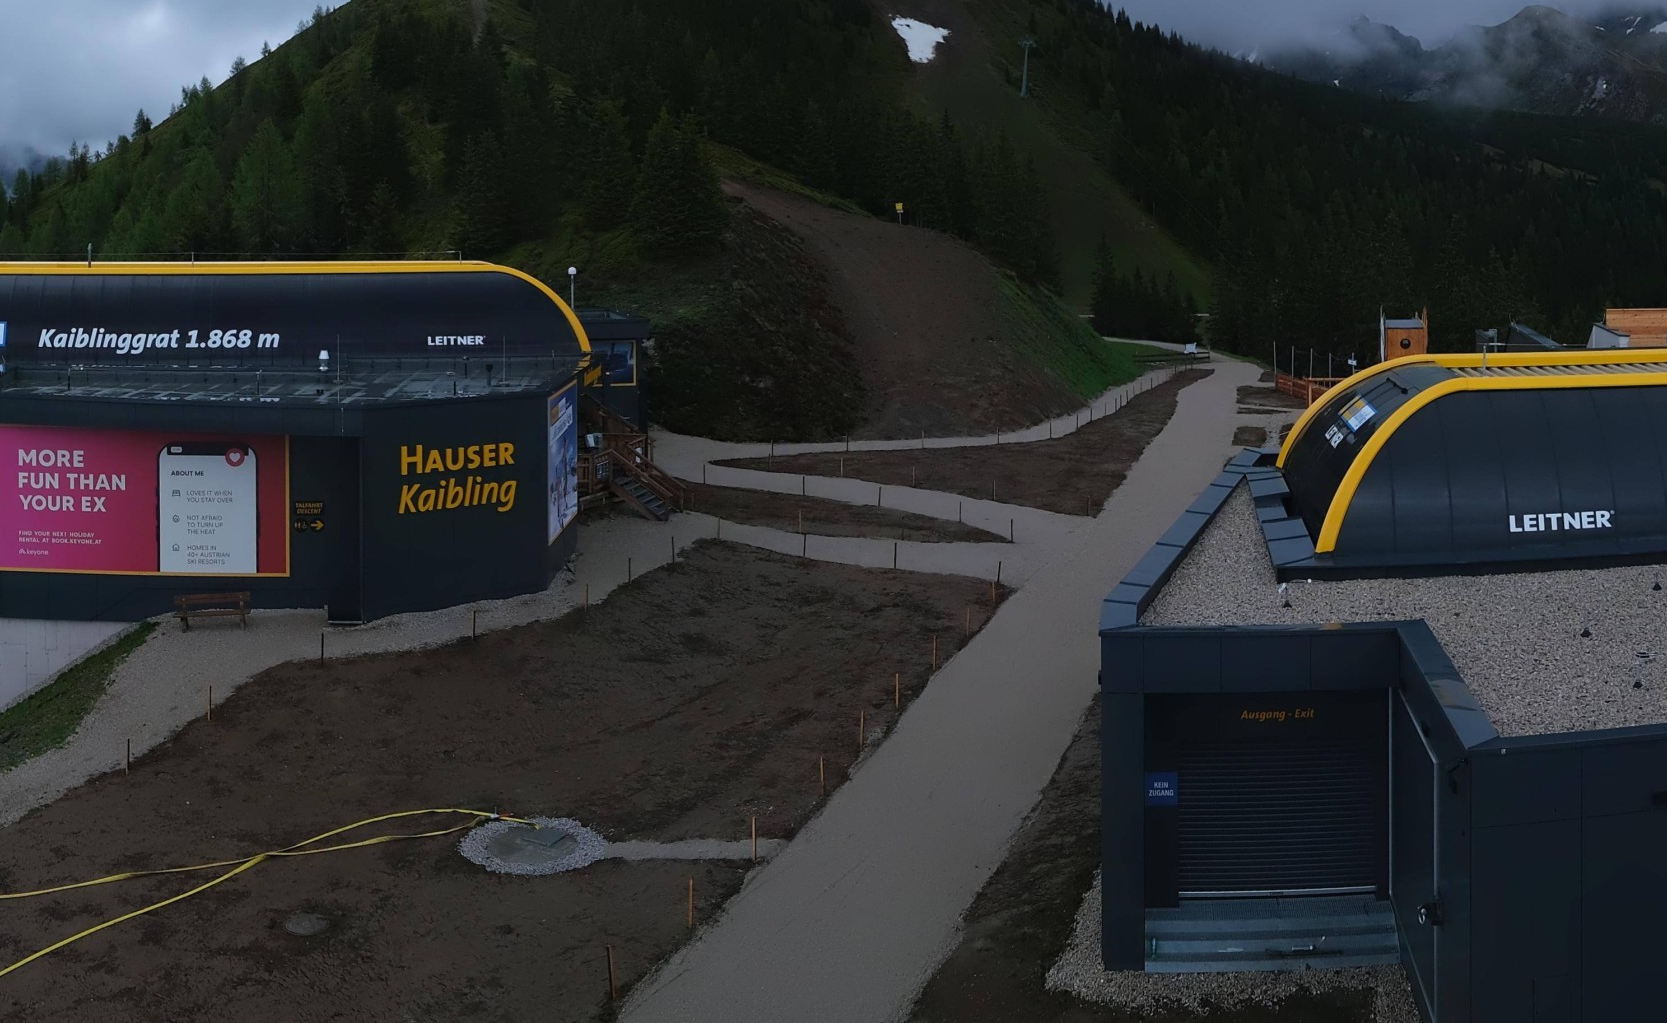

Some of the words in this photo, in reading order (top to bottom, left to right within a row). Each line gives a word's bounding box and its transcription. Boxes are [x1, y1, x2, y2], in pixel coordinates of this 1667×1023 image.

[38, 327, 180, 355] Kaiblinggrat
[185, 329, 252, 349] 1.868
[258, 333, 280, 348] m
[427, 335, 485, 346] LEITNER
[18, 449, 84, 467] MORE
[401, 442, 515, 475] HAUSER
[18, 472, 59, 489] FUN
[66, 473, 126, 491] THAN
[19, 495, 75, 511] YOUR
[81, 497, 106, 513] EX
[398, 476, 517, 514] Kaibling
[1509, 511, 1612, 533] LEITNER
[1241, 710, 1286, 721] Ausgang
[1294, 709, 1315, 718] Exit
[1148, 789, 1174, 797] ZUGANG
[1153, 781, 1169, 789] KEIN
